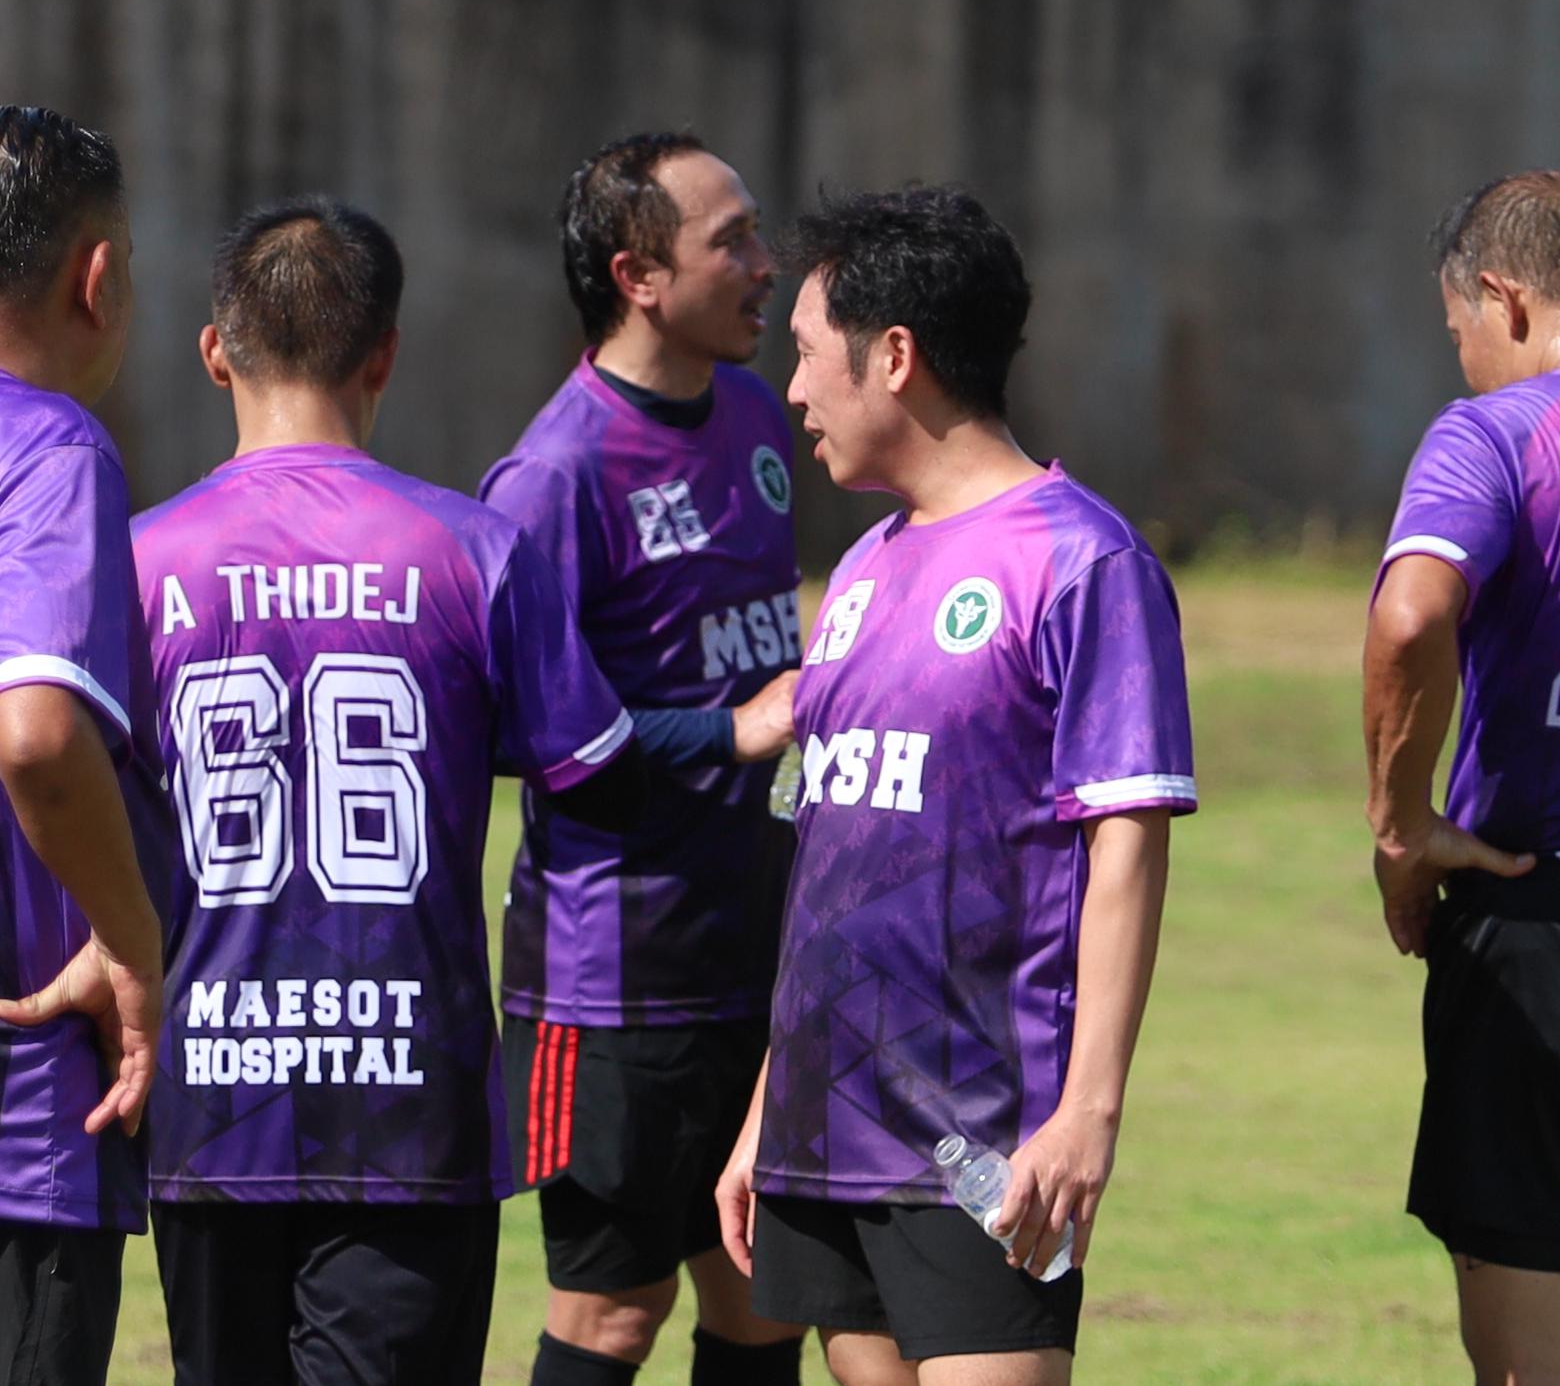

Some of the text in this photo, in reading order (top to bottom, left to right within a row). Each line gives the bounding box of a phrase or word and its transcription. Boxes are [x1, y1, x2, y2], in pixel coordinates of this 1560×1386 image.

[163, 563, 420, 635] A THIDEJ
[170, 653, 428, 909] 66
[187, 979, 421, 1028] MAESOT
[184, 1037, 424, 1085] HOSPITAL
